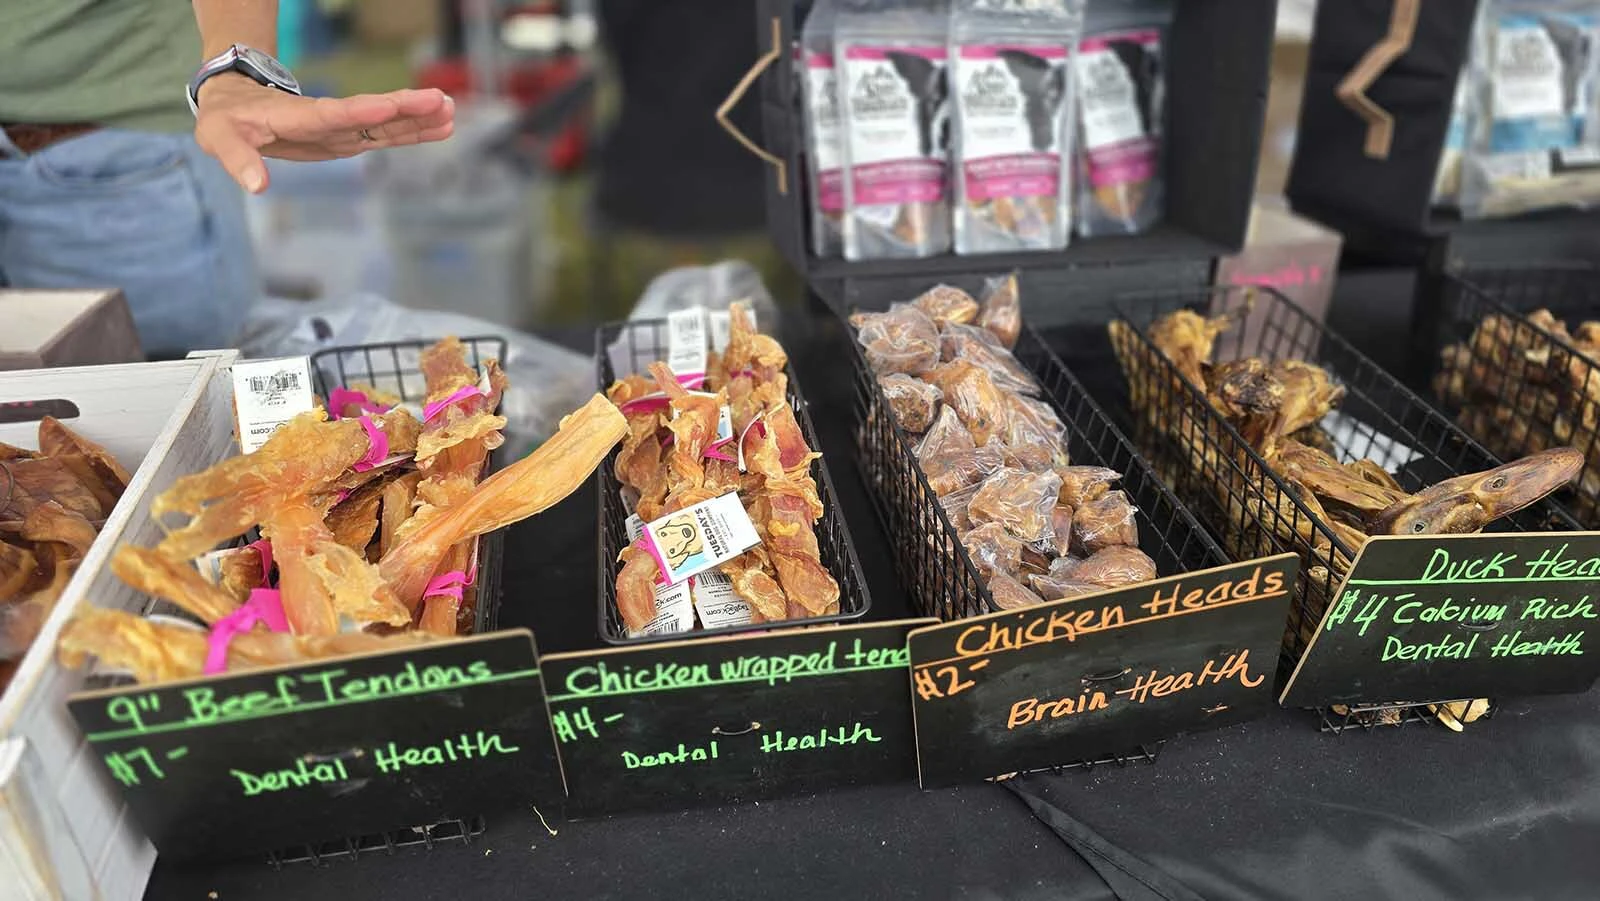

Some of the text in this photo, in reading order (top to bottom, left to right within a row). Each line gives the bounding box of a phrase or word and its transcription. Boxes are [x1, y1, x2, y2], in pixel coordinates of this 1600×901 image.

[695, 508, 723, 558] TUESDAY'S
[1420, 543, 1600, 581] Duck Hea
[954, 566, 1284, 659] Chicken Heads
[1391, 598, 1507, 625] Calcium
[1520, 595, 1599, 621] Rich
[565, 661, 711, 695] Chicken
[720, 641, 837, 687] wrapped
[1381, 631, 1585, 662] Dental Health
[108, 660, 493, 732] 9" Beef Tendons
[1007, 649, 1265, 730] Brain Health
[230, 731, 519, 796] Dental Health
[622, 722, 882, 769] Dental Health
